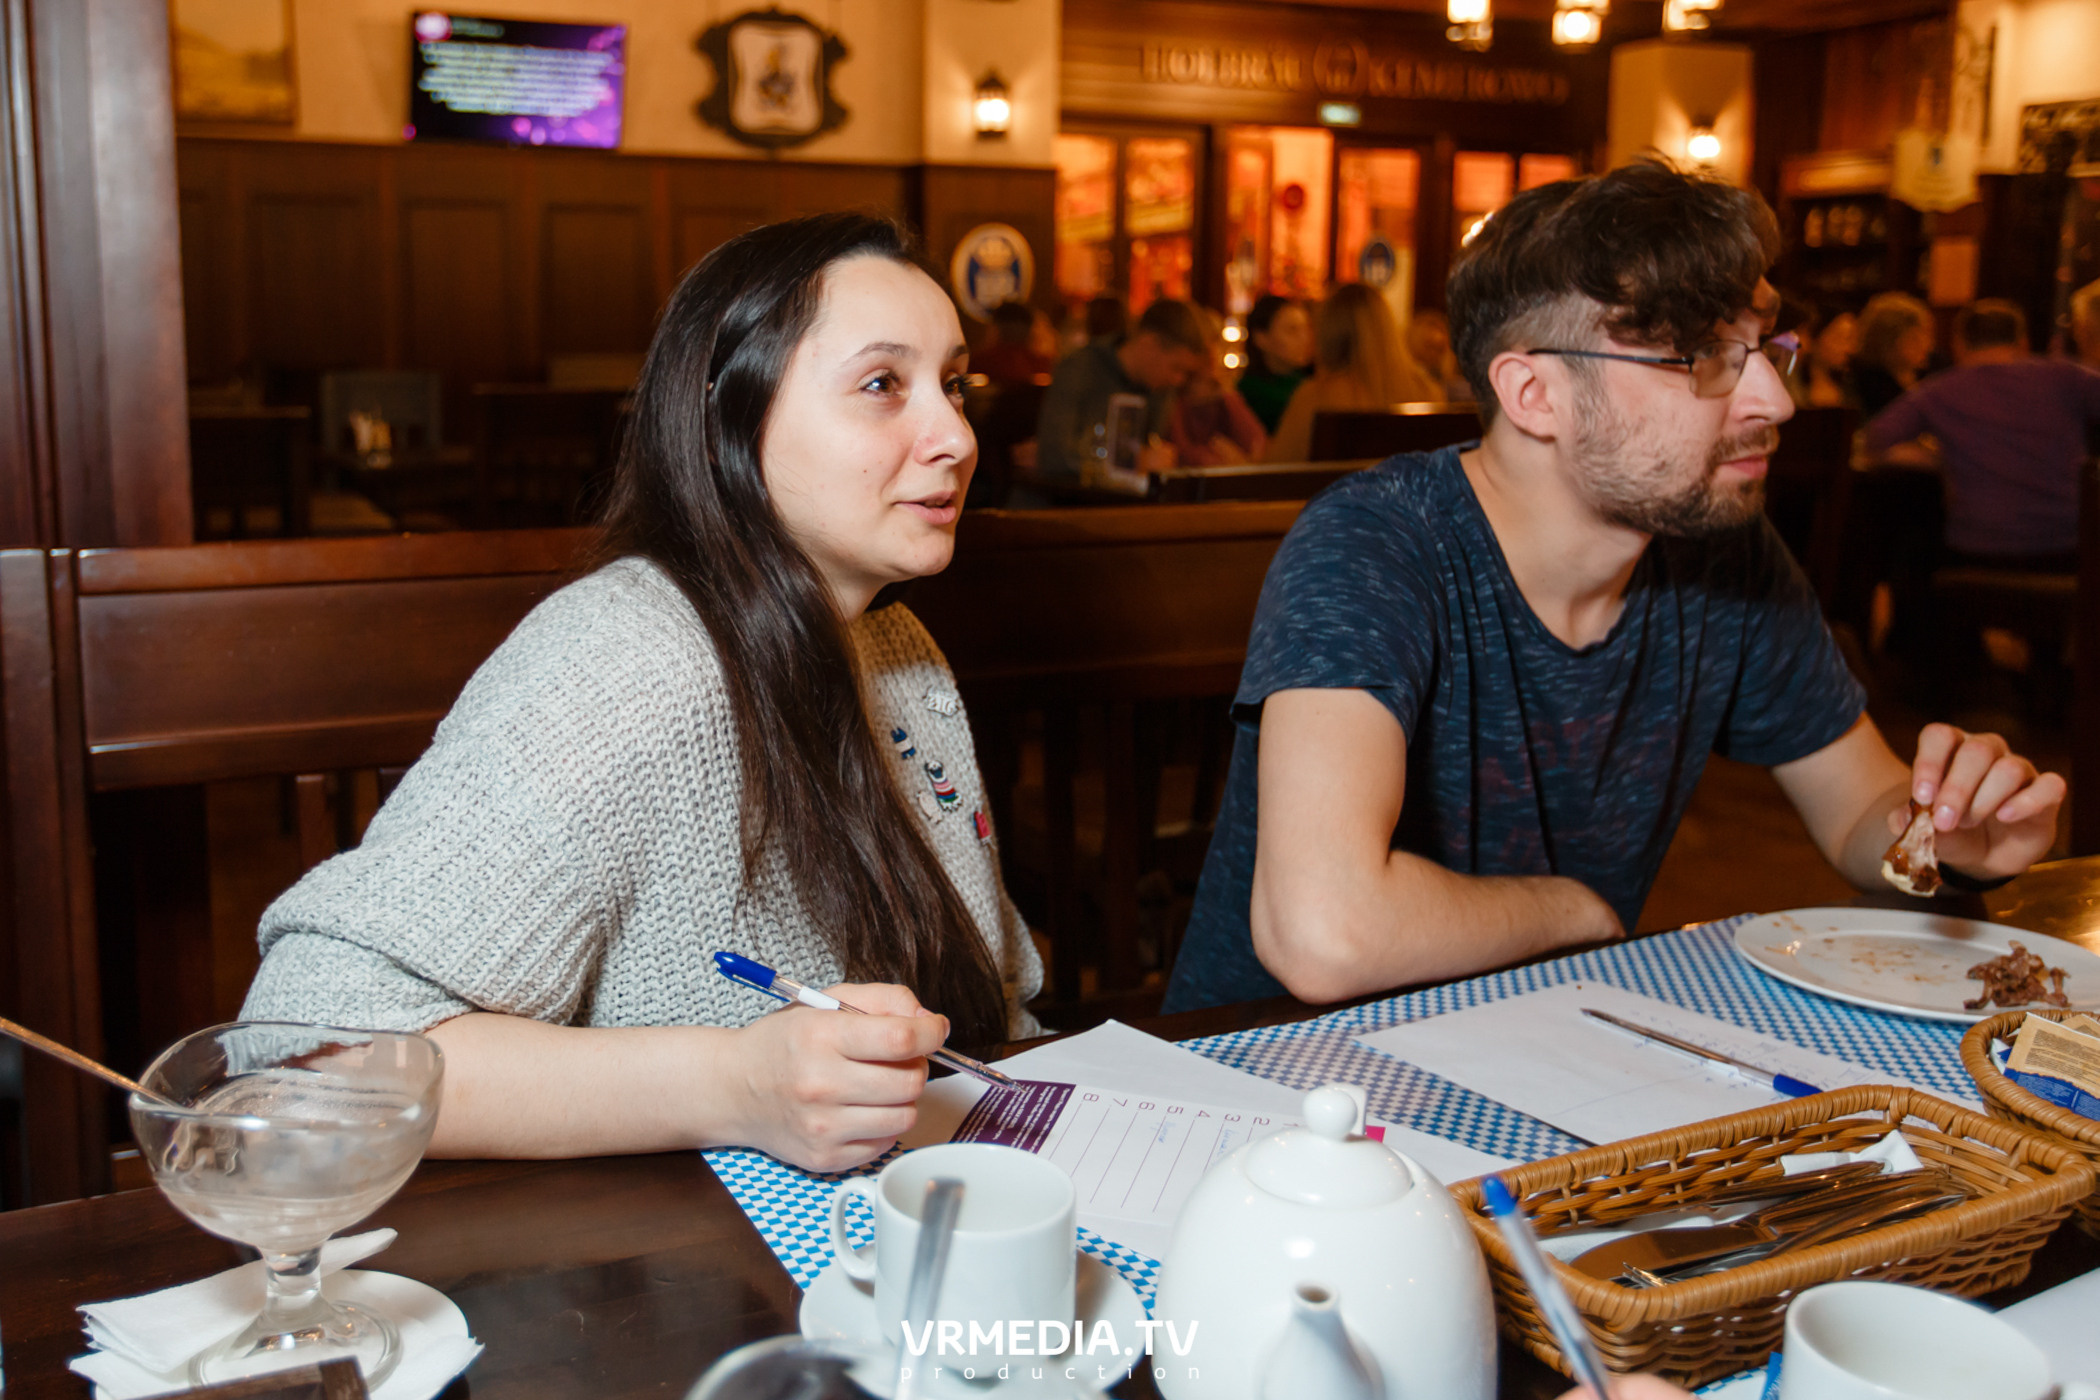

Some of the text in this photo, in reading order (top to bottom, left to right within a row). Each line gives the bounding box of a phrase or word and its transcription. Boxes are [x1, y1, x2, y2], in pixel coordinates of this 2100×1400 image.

[1083, 1092, 1100, 1103] 8
[1112, 1097, 1129, 1108] 7
[1138, 1101, 1155, 1111] 6
[1166, 1105, 1184, 1115] 5
[1197, 1109, 1211, 1120] 4
[1223, 1113, 1241, 1123] 3
[1252, 1116, 1271, 1126] 2
